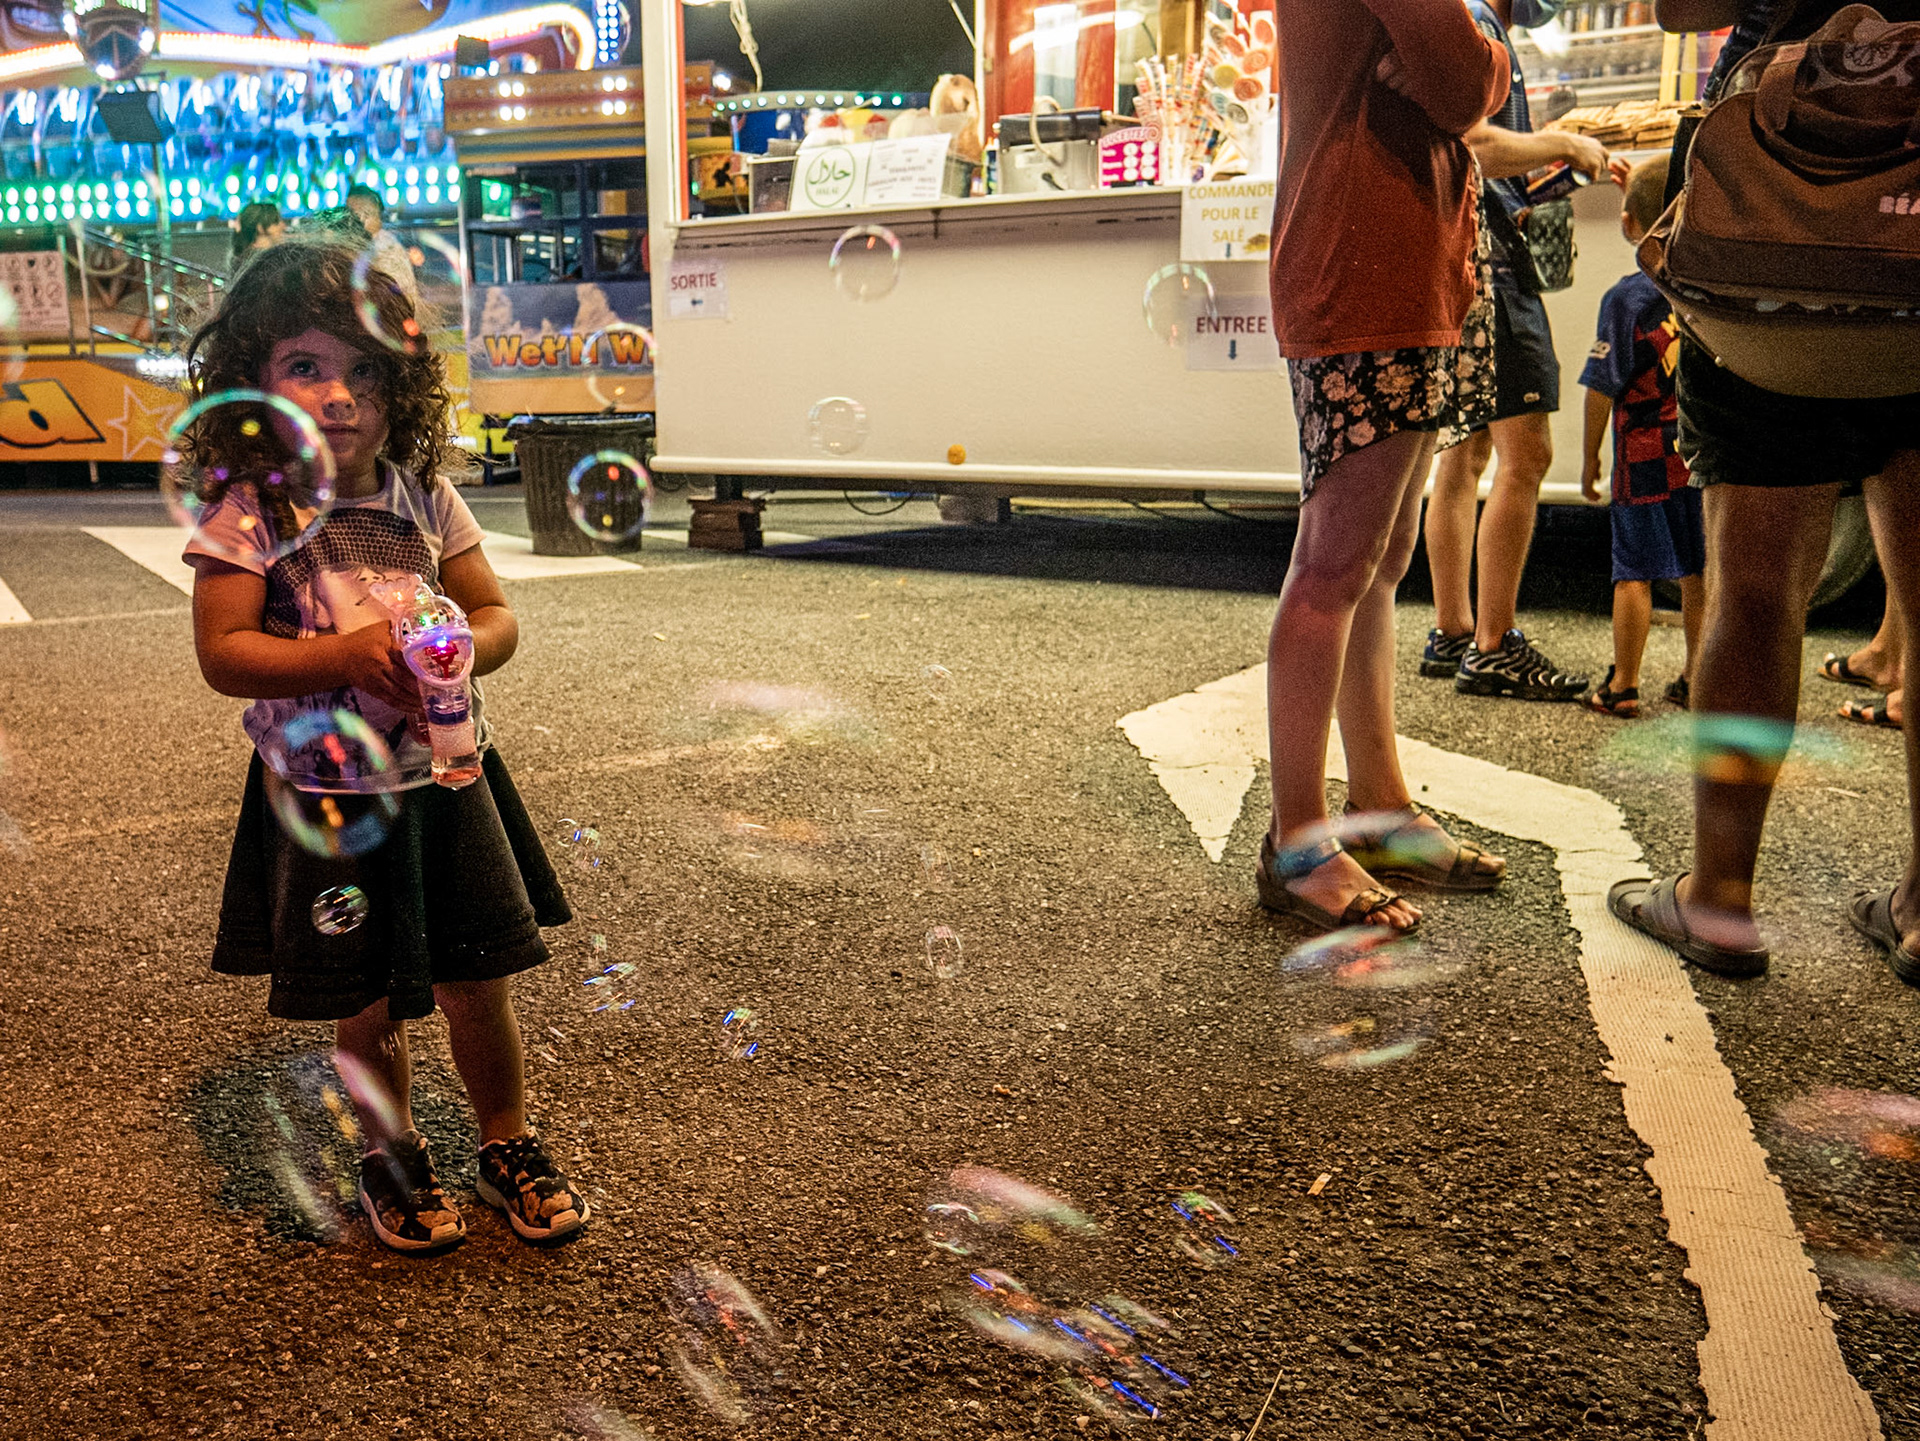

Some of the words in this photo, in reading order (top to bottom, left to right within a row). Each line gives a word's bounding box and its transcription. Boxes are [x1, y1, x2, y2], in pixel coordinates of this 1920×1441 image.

[808, 158, 851, 185] حلال
[1188, 183, 1275, 199] COMMANDE
[1201, 207, 1240, 221] POUR
[1244, 206, 1259, 220] LE
[1212, 225, 1245, 243] SALÉ
[670, 272, 717, 291] SORTIE
[1196, 315, 1267, 334] ENTREE
